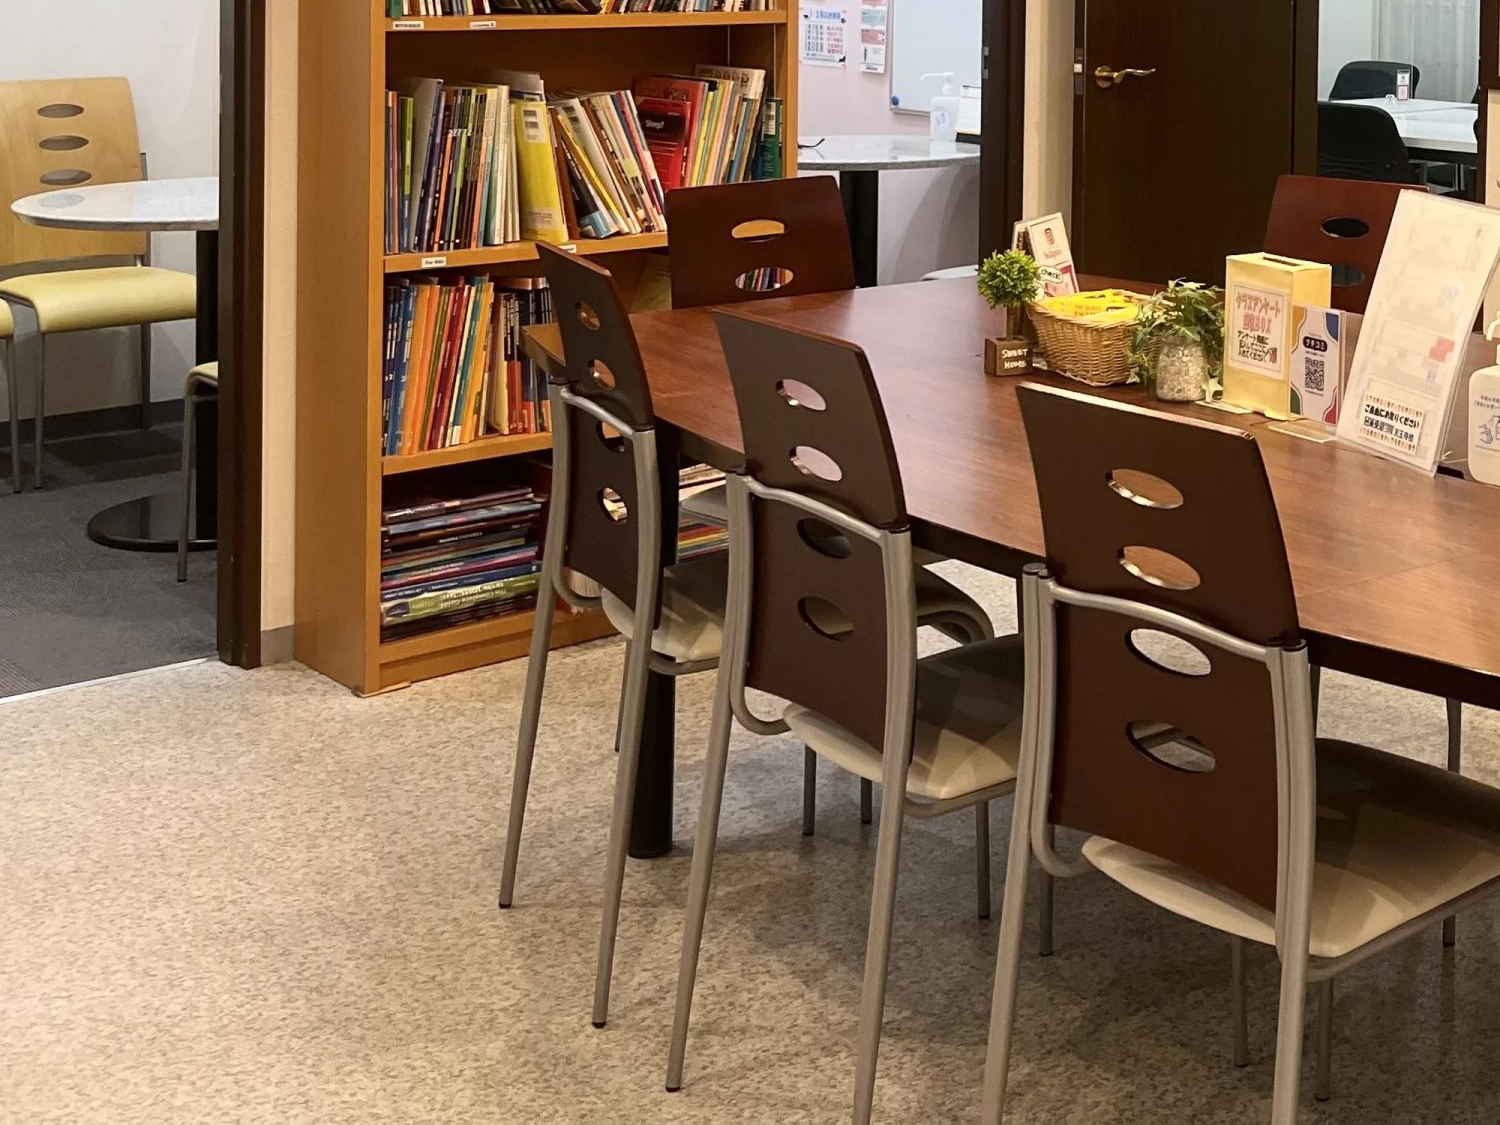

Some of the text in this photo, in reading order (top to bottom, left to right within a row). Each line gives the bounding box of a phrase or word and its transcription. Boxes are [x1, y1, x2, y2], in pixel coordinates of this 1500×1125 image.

[1004, 360, 1027, 370] HOME
[1364, 404, 1420, 429] ご自由にお取りください
